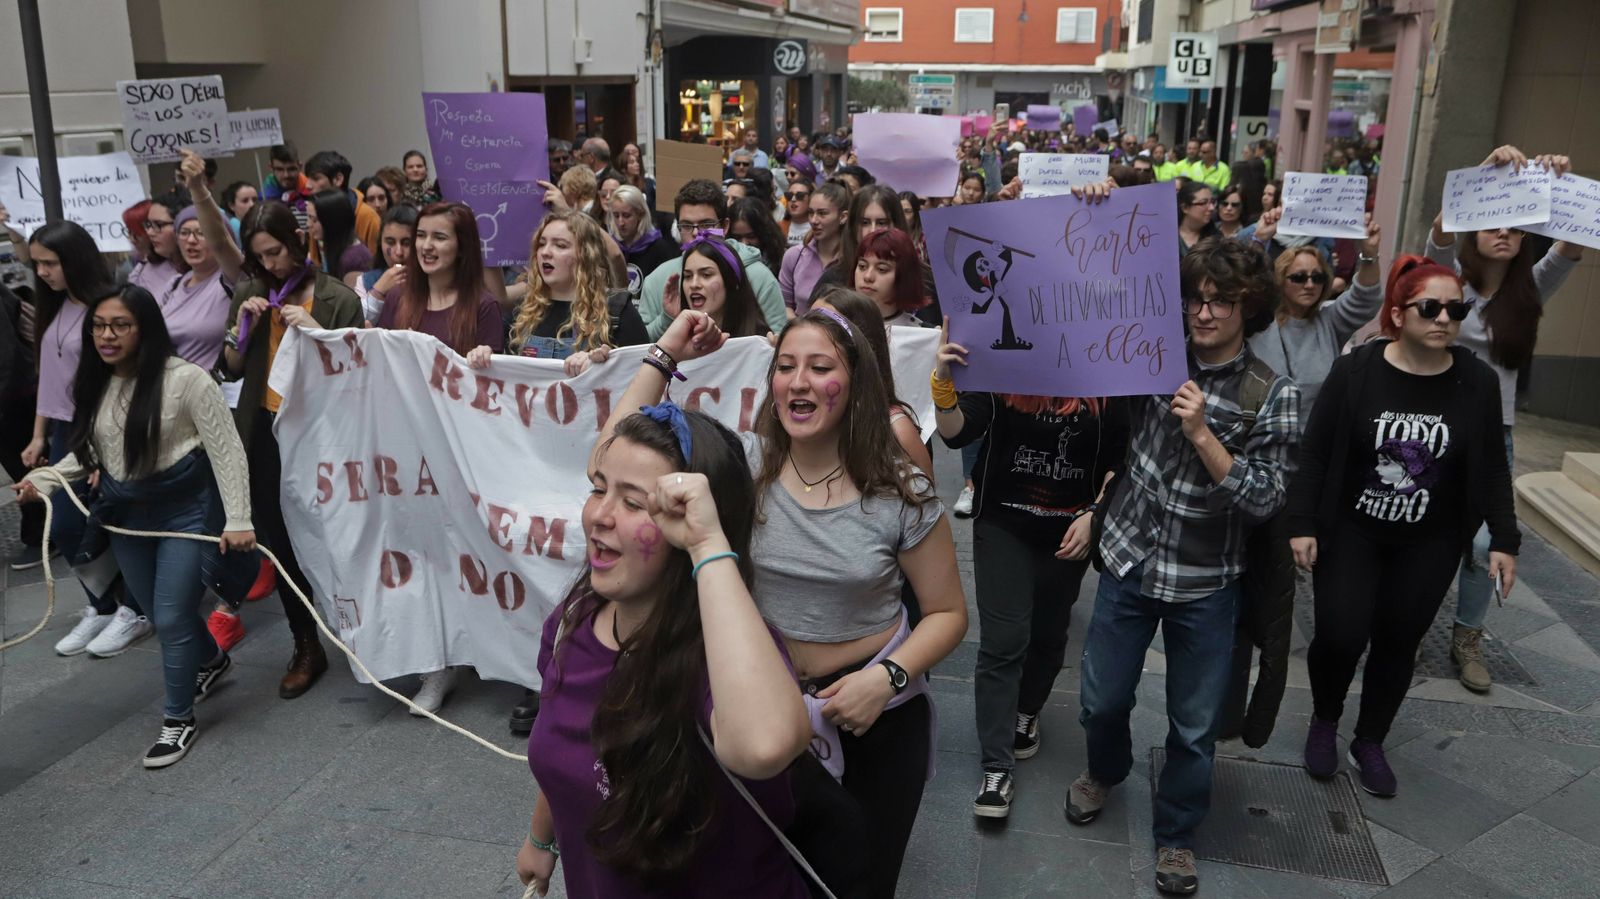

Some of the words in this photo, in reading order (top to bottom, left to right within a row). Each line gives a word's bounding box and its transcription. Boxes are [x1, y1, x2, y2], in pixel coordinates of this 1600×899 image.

[126, 83, 174, 105] SEXO
[156, 105, 183, 122] LOS
[245, 117, 278, 131] LUCHA
[1288, 216, 1358, 226] FEMINISMO
[1455, 202, 1538, 223] FEMINISMO
[1028, 285, 1048, 325] DE
[314, 331, 368, 377] LA
[1057, 333, 1072, 369] A
[1083, 323, 1168, 377] ellas
[1374, 419, 1450, 459] TODO
[315, 455, 440, 505] SERA
[1355, 488, 1430, 523] MIEDO
[380, 550, 414, 589] O
[458, 553, 526, 611] NO
